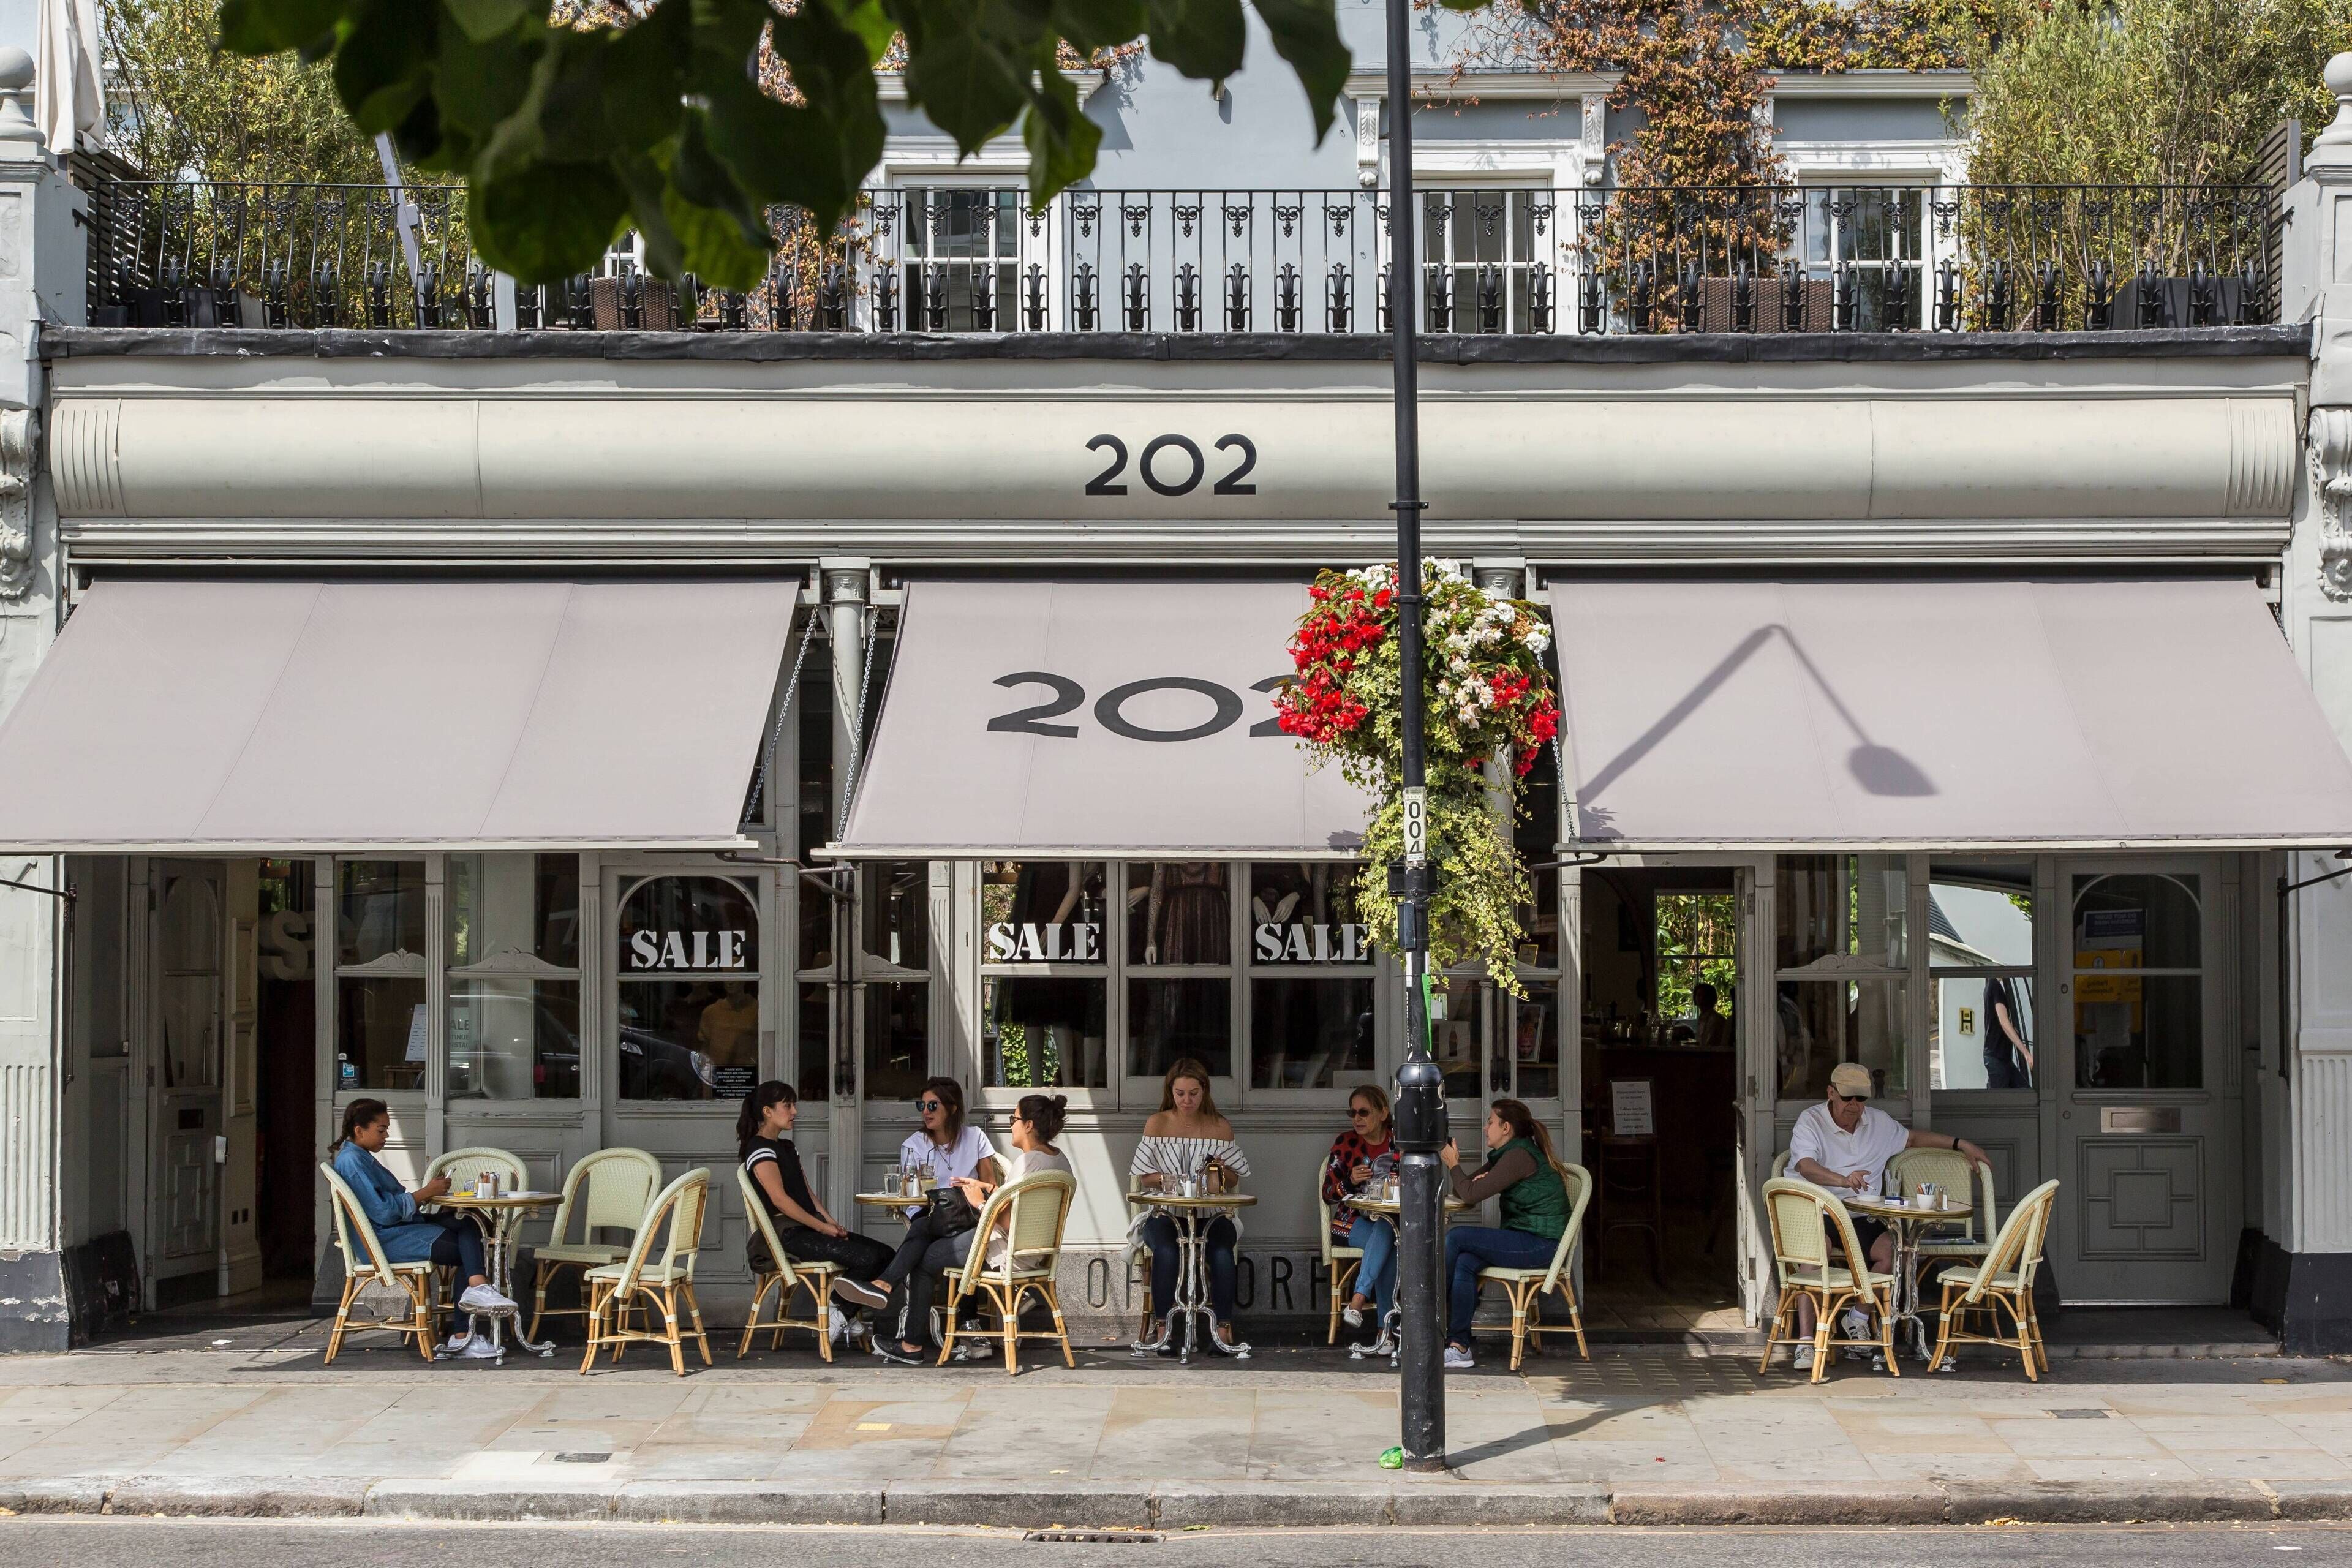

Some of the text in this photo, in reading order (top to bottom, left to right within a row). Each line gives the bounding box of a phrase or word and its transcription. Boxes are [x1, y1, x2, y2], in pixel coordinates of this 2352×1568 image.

[1085, 434, 1256, 497] 202
[632, 930, 745, 968] SALE
[984, 922, 1099, 961] SALE
[1256, 923, 1368, 960] SALE
